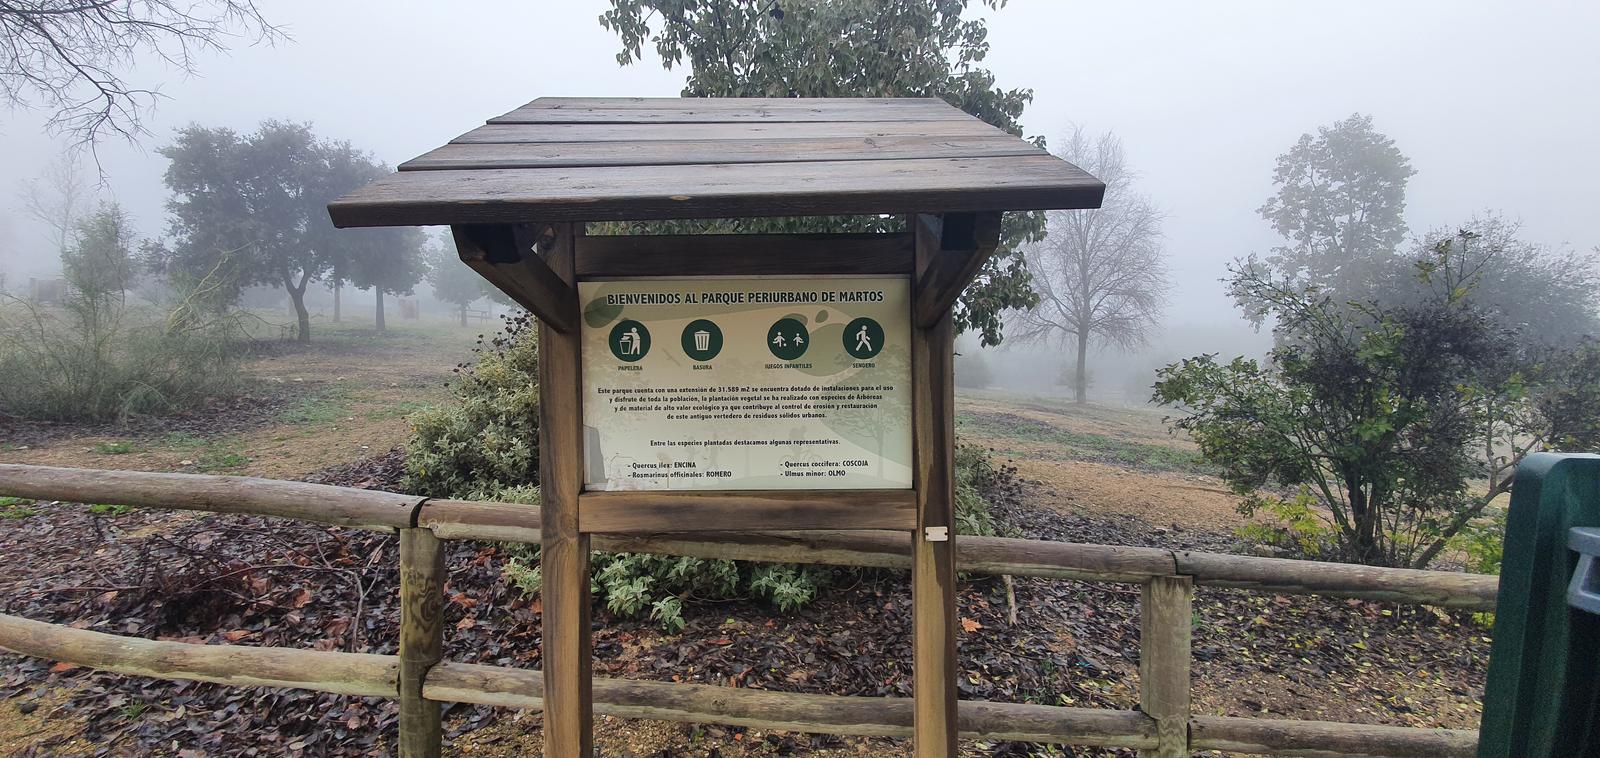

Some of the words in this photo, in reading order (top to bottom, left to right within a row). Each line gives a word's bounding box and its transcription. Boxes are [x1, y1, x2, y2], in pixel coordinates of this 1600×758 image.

[607, 293, 681, 305] BIENVENIDOS
[685, 293, 698, 304] AL
[702, 292, 744, 305] PARQUE
[748, 291, 818, 303] PERIURBANO
[822, 292, 835, 302] DE
[840, 291, 883, 302] MARTOS
